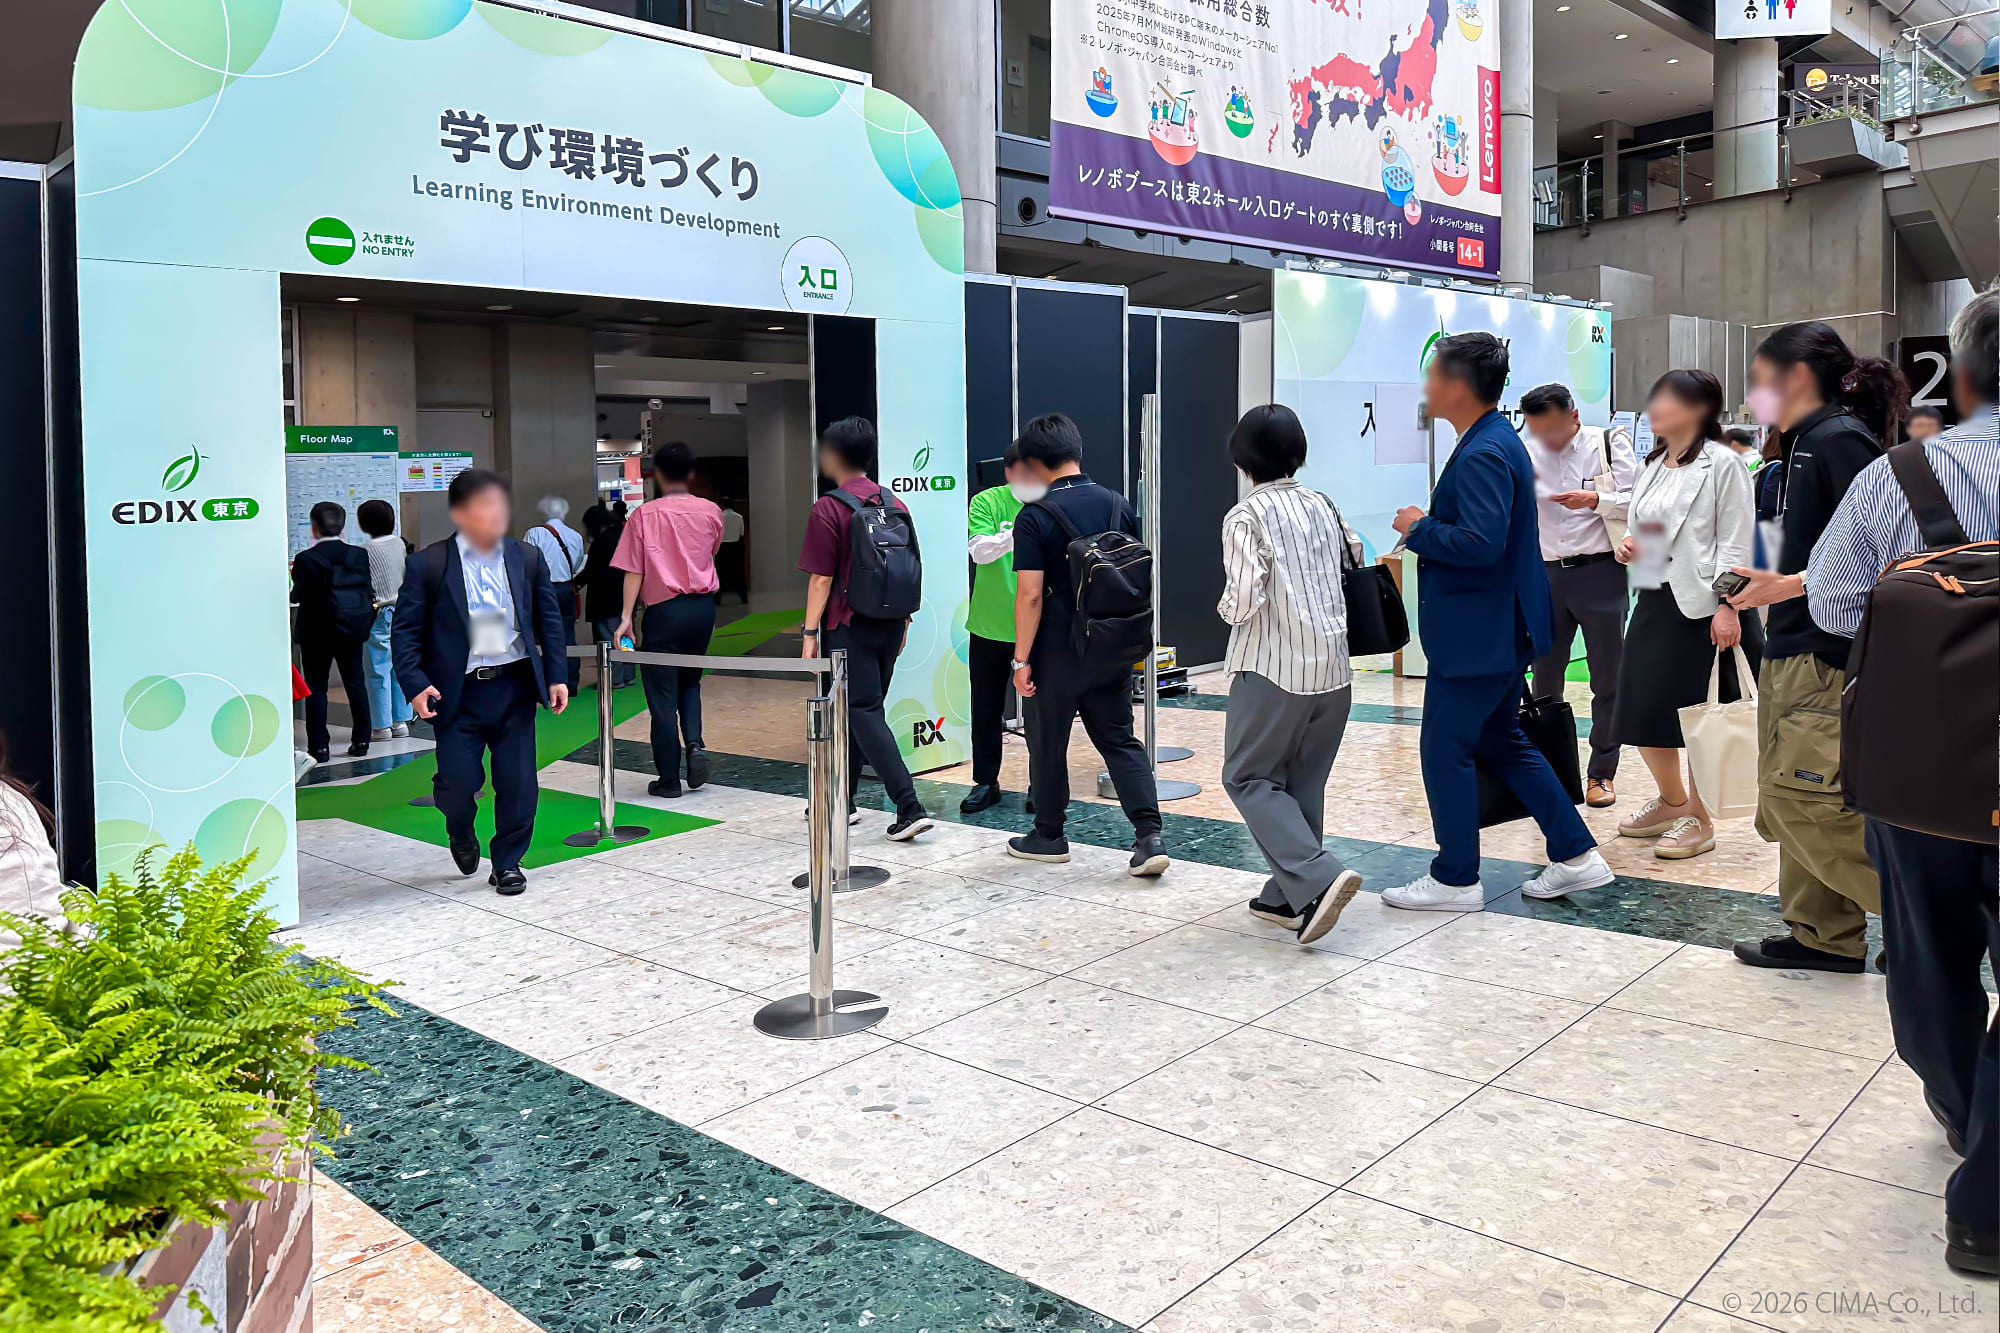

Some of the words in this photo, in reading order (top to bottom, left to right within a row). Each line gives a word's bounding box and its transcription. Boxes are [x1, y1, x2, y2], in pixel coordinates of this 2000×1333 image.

[1189, 0, 1271, 28] 用総合数
[1096, 21, 1234, 71] ChromeOS導入のメーカーシェアより
[1483, 79, 1494, 183] Lenovo
[440, 109, 760, 201] 学び環境づくり
[412, 174, 513, 211] Learning
[522, 188, 654, 224] Environment
[660, 205, 781, 239] Development
[362, 231, 415, 247] 入れません
[362, 245, 380, 255] NO
[381, 246, 415, 258] ENTRY
[1459, 243, 1482, 263] 14-1
[798, 265, 838, 290] 入口
[803, 291, 834, 300] ENTRANCE
[1911, 351, 1948, 407] 2
[300, 434, 328, 444] Floor
[330, 434, 353, 446] Map
[891, 476, 929, 493] EDIX
[934, 478, 952, 489] 東京
[111, 499, 199, 525] EDIX
[211, 501, 250, 518] 東京
